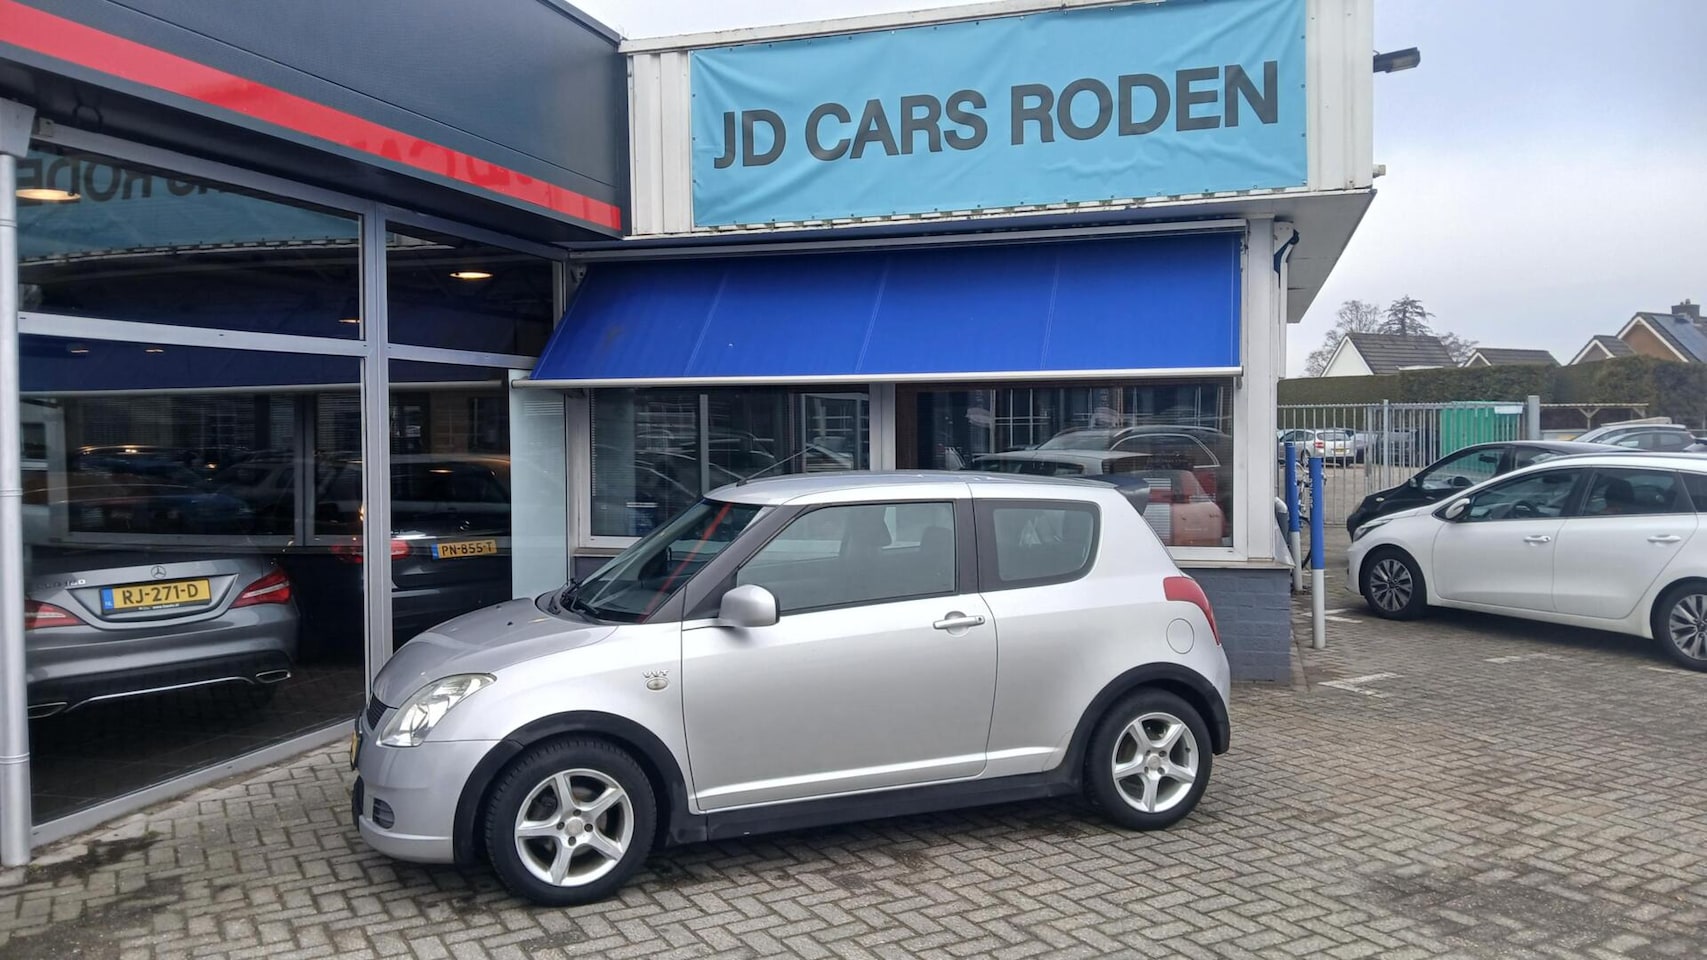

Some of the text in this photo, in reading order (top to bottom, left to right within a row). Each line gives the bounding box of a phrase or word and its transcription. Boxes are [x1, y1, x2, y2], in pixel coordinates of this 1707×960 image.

[713, 61, 1278, 169] JD CARS RODEN
[440, 541, 493, 557] PN-855-T
[122, 584, 198, 605] RJ-271-D
